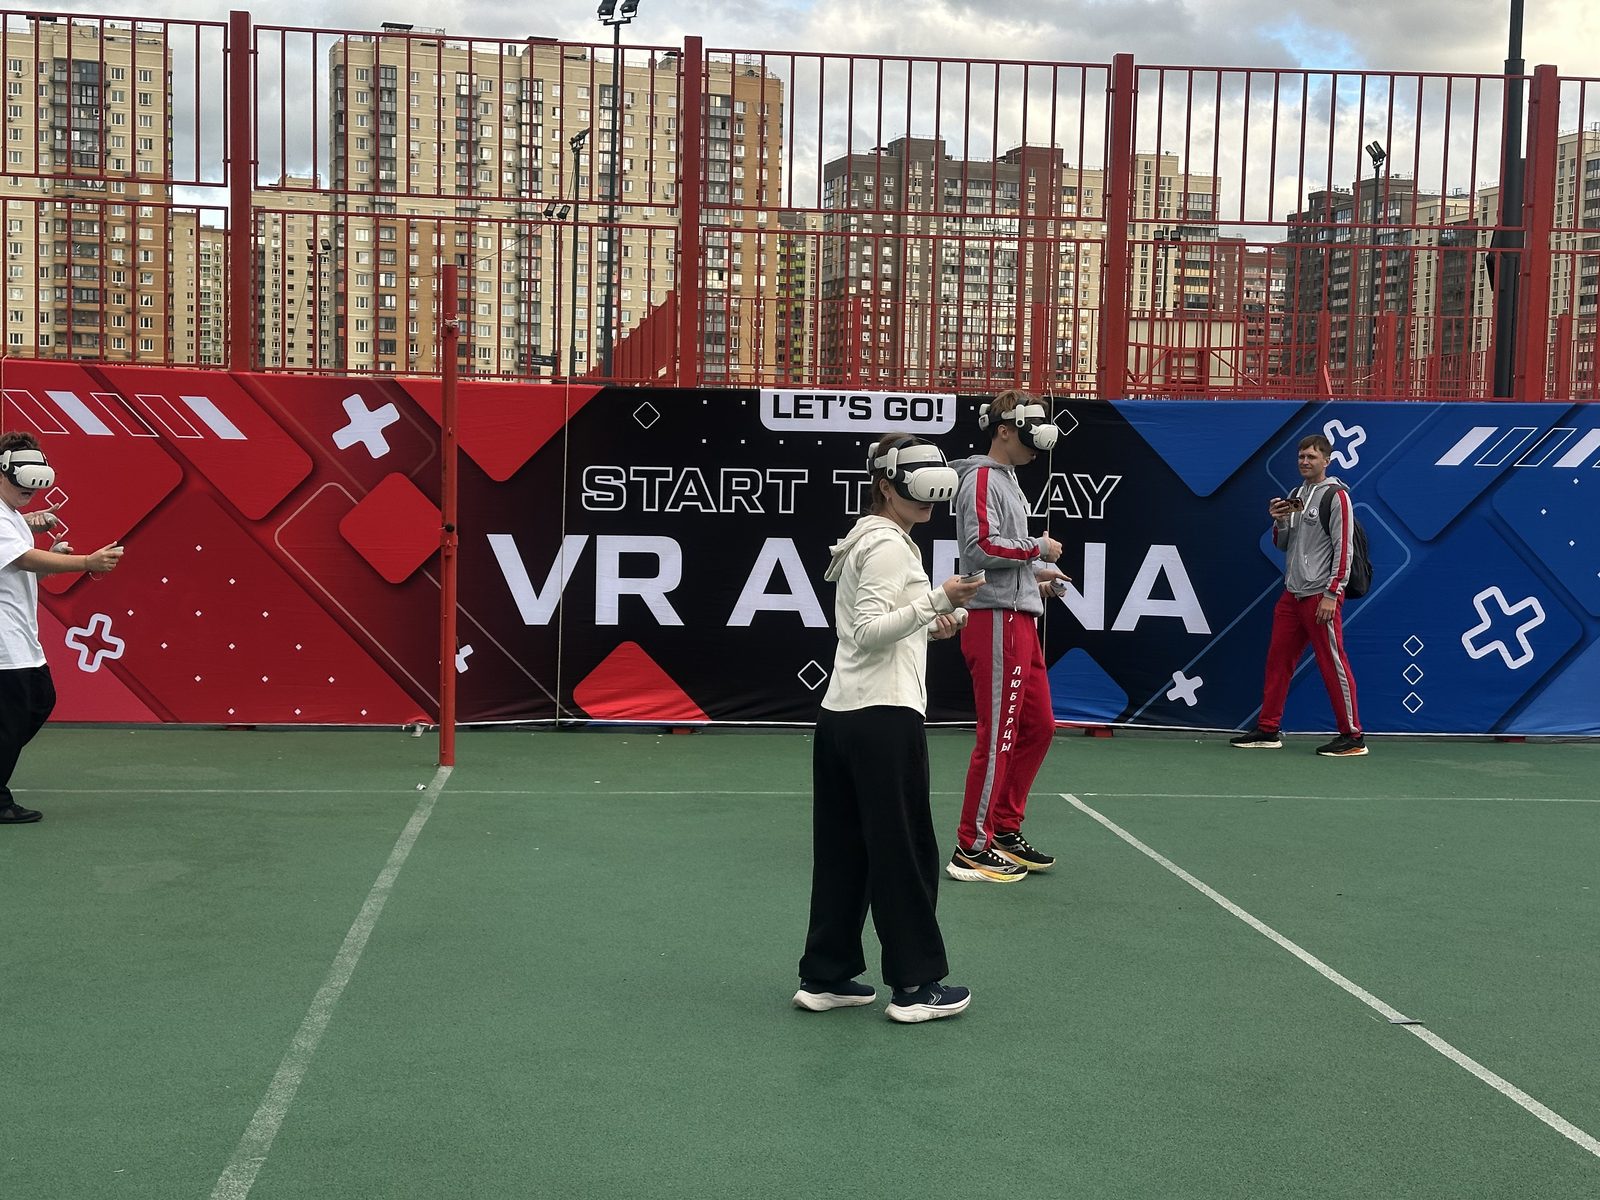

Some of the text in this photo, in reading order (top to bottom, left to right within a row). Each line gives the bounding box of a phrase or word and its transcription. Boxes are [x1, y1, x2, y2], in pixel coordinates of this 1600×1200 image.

[773, 394, 944, 422] LET'S GO!
[581, 465, 809, 514] START
[949, 472, 1123, 519] AY
[486, 533, 1212, 634] VR ANA
[999, 665, 1022, 753] ЛЮБЕРЦЫ
